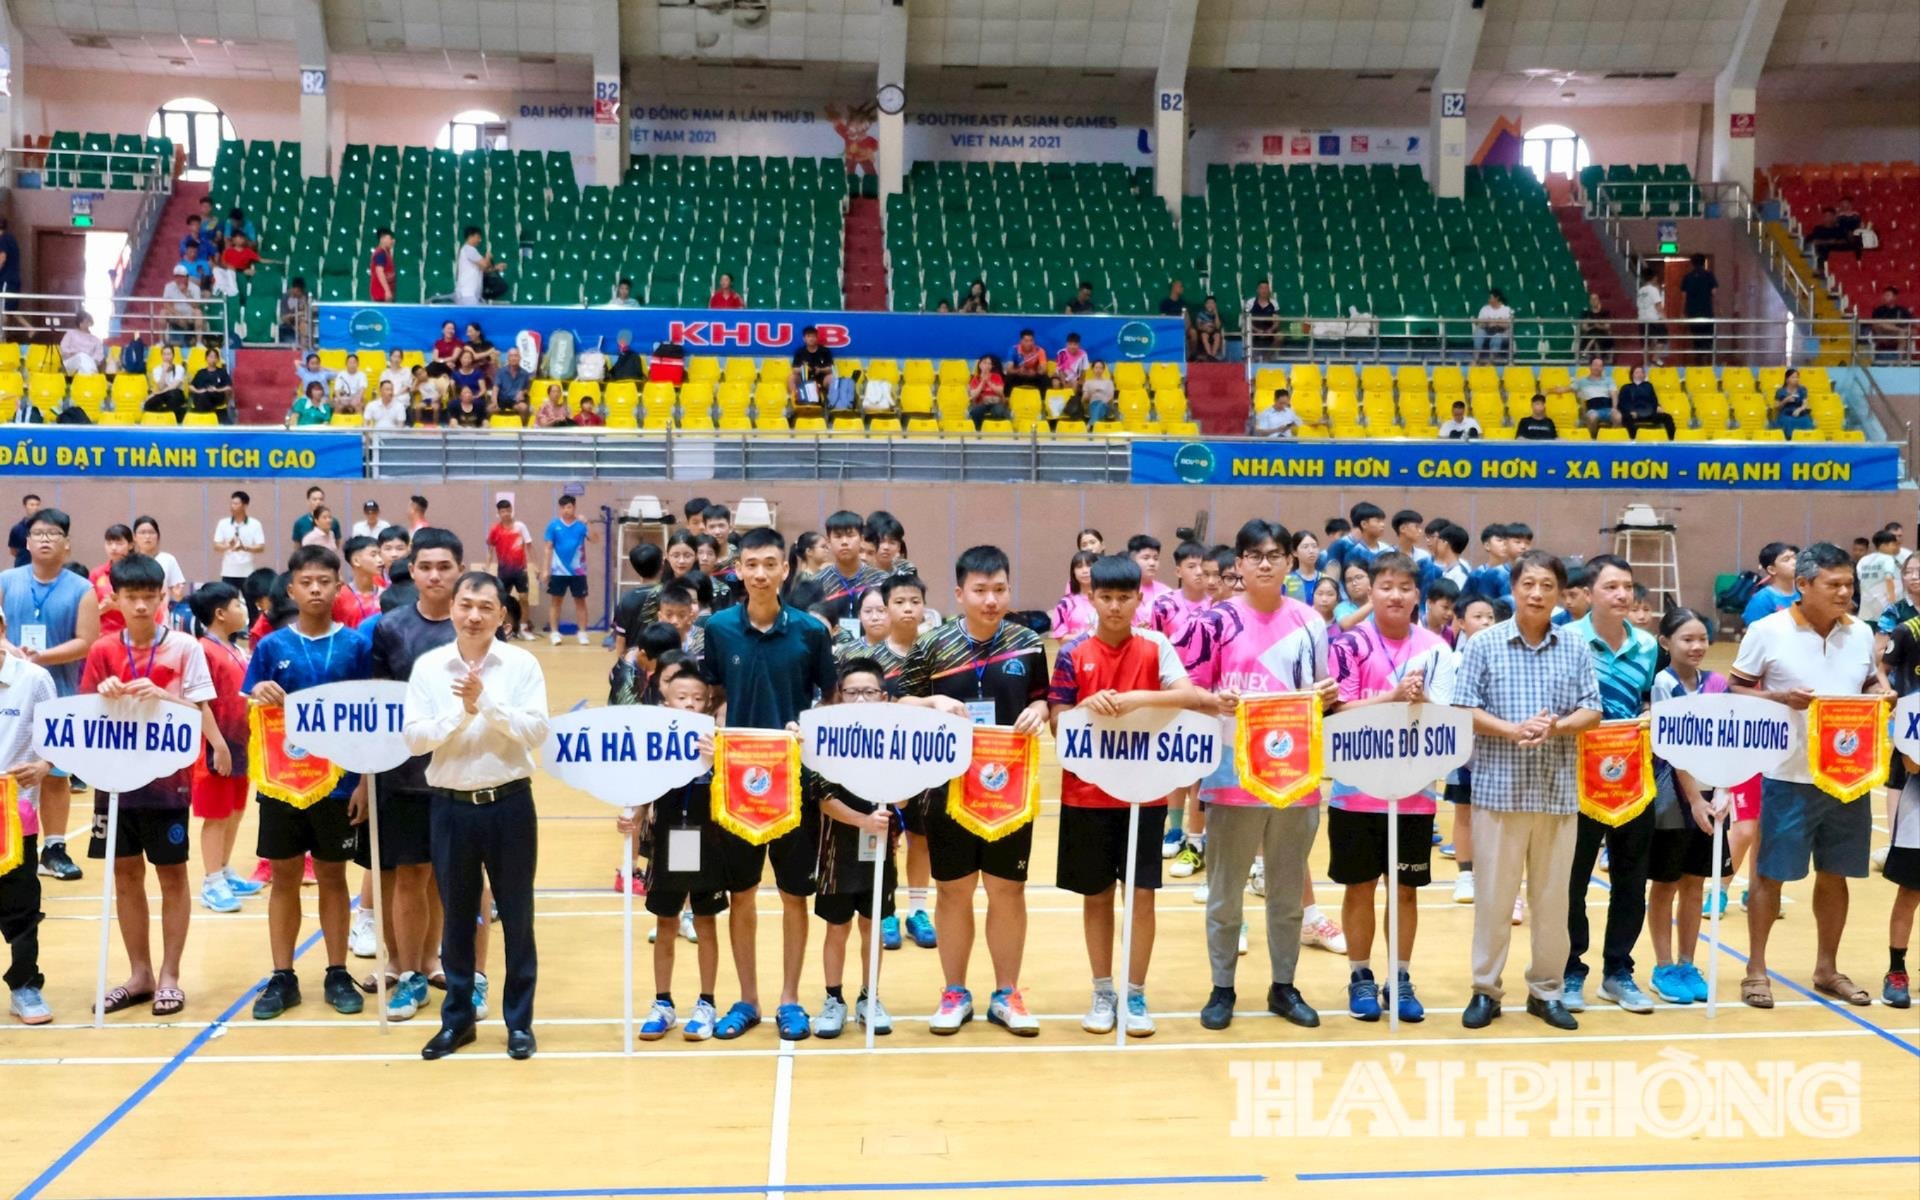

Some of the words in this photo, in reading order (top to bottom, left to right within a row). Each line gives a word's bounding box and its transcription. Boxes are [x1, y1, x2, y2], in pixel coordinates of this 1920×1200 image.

[302, 70, 325, 95] B2
[596, 81, 618, 100] B2
[520, 105, 545, 121] ĐẠI
[648, 103, 689, 121] ĐÔNG
[692, 107, 724, 121] NAM
[1160, 92, 1183, 112] B2
[1442, 94, 1465, 117] B2
[916, 113, 1008, 127] SOUTHEAST
[1012, 114, 1059, 128] ASIAN
[1063, 115, 1118, 129] GAMES
[653, 129, 685, 142] NAM
[688, 130, 717, 143] 2021
[951, 133, 985, 148] VIET
[988, 134, 1025, 148] NAM
[1028, 135, 1061, 148] 2021
[668, 320, 794, 348] KHU
[815, 322, 852, 348] B
[0, 437, 48, 466] ĐẤU
[55, 446, 106, 470] ĐẠT
[114, 443, 197, 468] THÀNH
[205, 443, 260, 468] TÍCH
[269, 449, 316, 469] CAO
[1232, 458, 1324, 477] NHANH
[1335, 457, 1390, 477] HƠN
[1417, 459, 1472, 478] CAO
[1481, 457, 1537, 478] HƠN
[1566, 460, 1601, 479] XA
[1611, 458, 1669, 480] HƠN
[1698, 461, 1781, 485] MẠNH
[1792, 460, 1851, 481] HƠN
[296, 698, 326, 732] XÃ
[333, 697, 378, 733] PHÚ
[1904, 711, 1920, 741] X
[43, 713, 75, 748] XÃ
[83, 714, 138, 751] VĨNH
[145, 713, 192, 753] BẢO
[555, 727, 592, 763] XÃ
[601, 725, 637, 762] HÀ
[646, 719, 701, 762] BẮC
[889, 724, 907, 761] ÁI
[1064, 723, 1094, 759] XÃ
[1099, 729, 1151, 761] NAM
[1156, 725, 1214, 764] SÁCH
[1332, 724, 1394, 763] PHƯỜNG
[1424, 723, 1456, 758] SƠN
[1658, 711, 1714, 748] PHƯỜNG
[1717, 709, 1740, 748] HẢI
[1743, 717, 1789, 752] DƯƠNG
